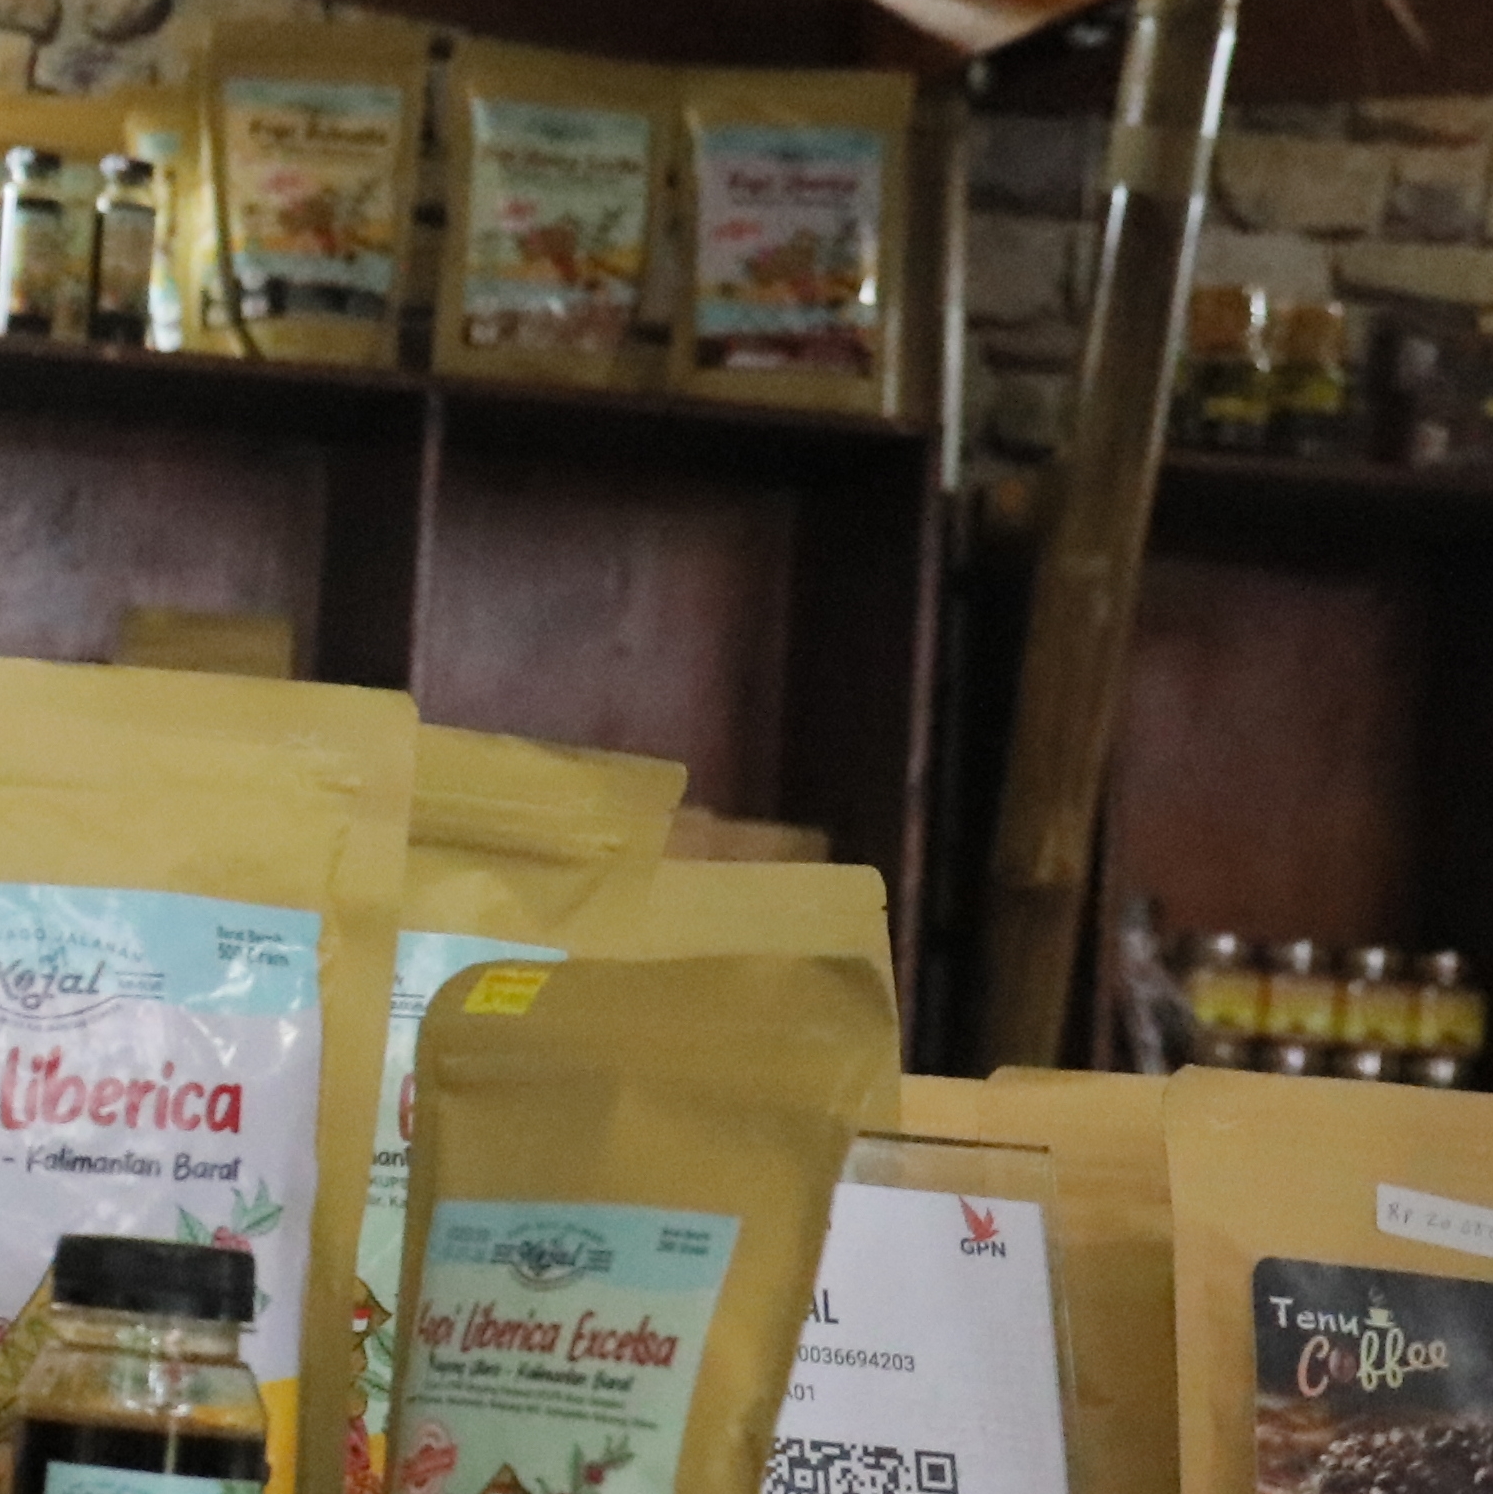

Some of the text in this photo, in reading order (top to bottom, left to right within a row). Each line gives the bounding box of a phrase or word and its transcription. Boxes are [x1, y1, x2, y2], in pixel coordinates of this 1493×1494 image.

[0, 1043, 244, 1135] Liberica
[26, 1137, 162, 1178] Kalimantan
[172, 1151, 242, 1183] Barat
[1269, 1295, 1360, 1338] Tenu
